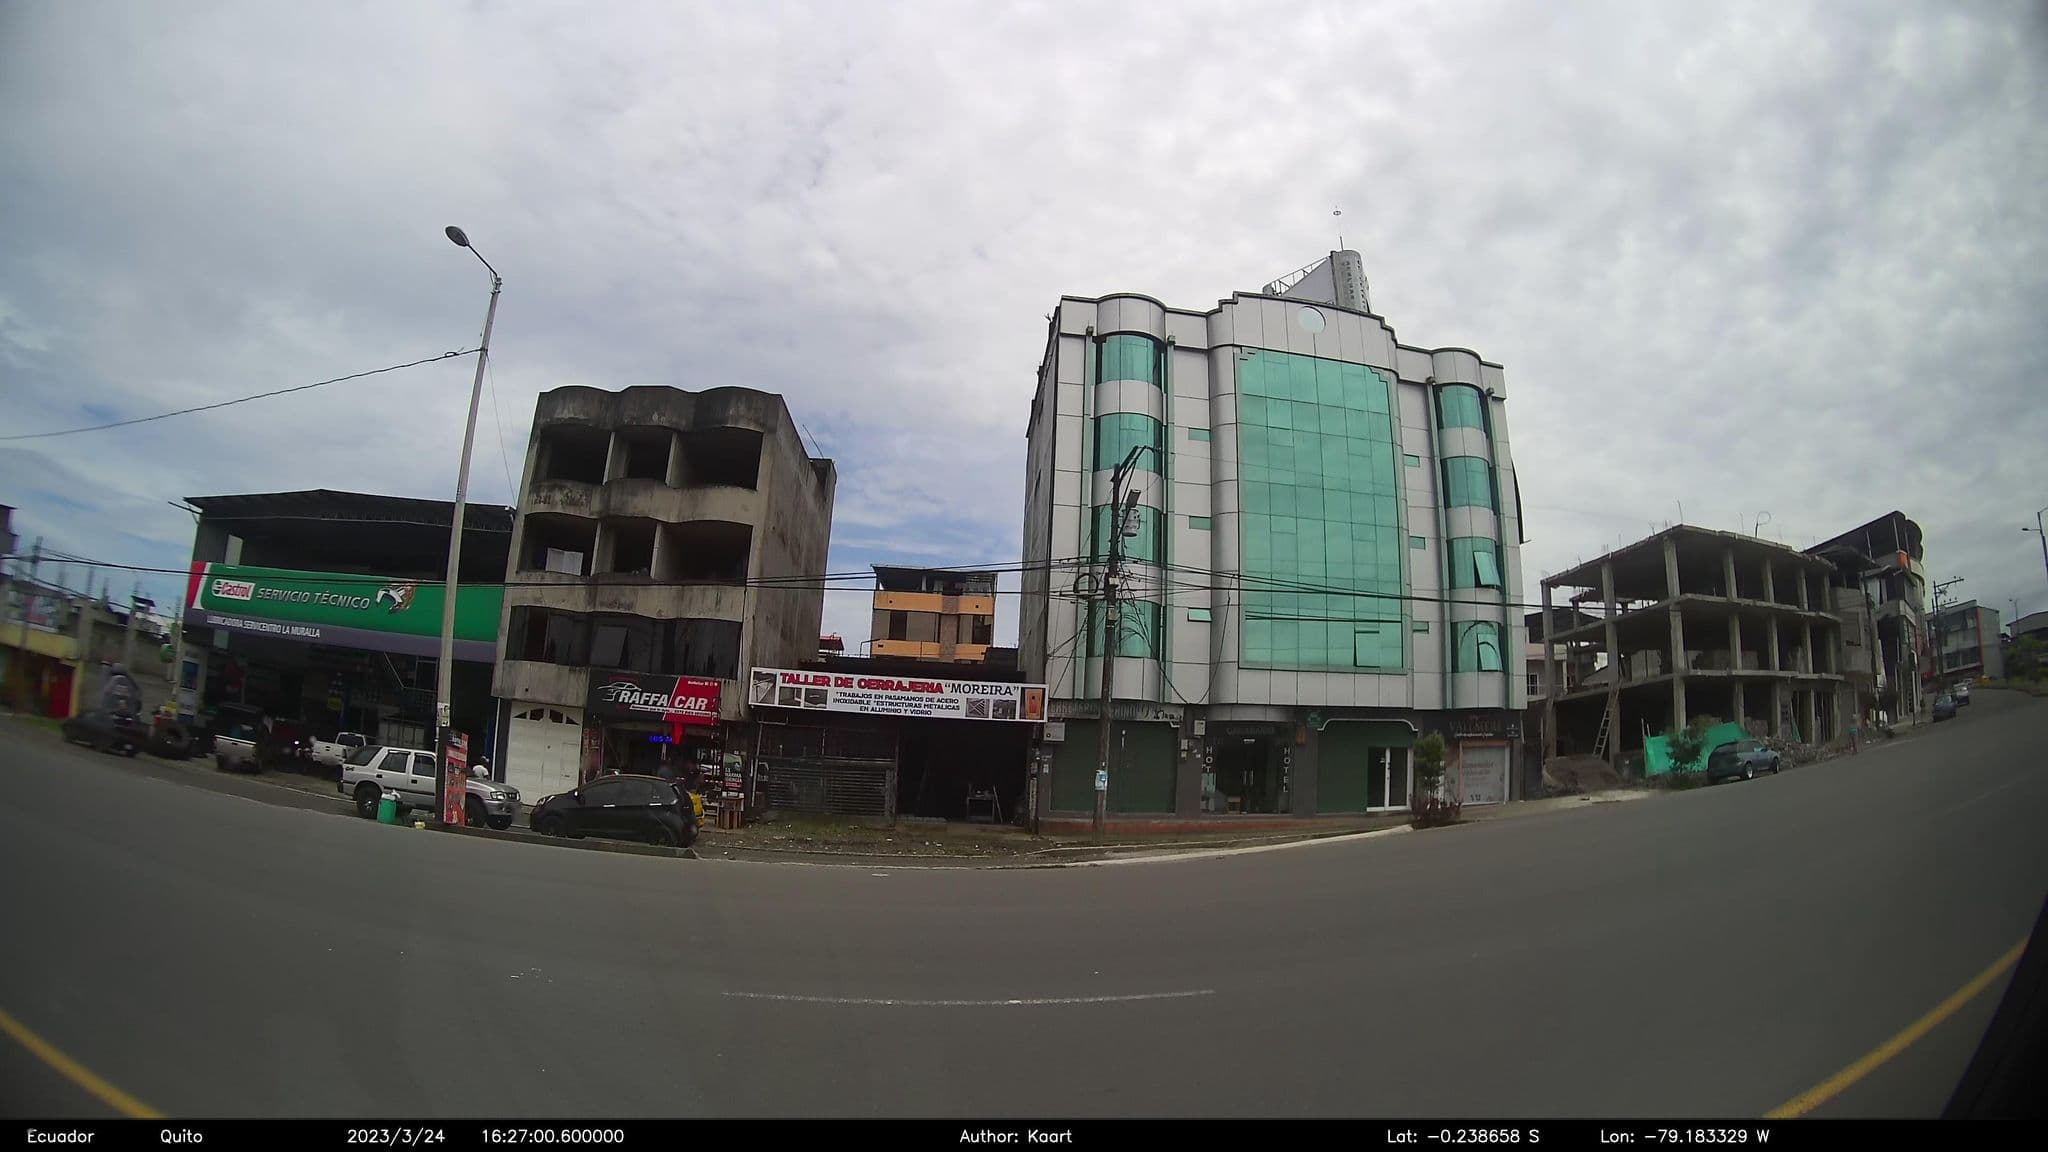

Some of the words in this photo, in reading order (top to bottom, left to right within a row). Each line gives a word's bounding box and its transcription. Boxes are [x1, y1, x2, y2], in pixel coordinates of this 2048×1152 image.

[221, 581, 253, 598] Castrol
[256, 587, 310, 604] SERVICIO
[313, 590, 371, 610] TÉCNICO
[282, 625, 290, 635] LA
[291, 626, 320, 638] MURALLA
[780, 672, 831, 687] TALLER
[834, 676, 855, 689] DE
[618, 690, 669, 707] RAFFA
[674, 696, 708, 711] CAR
[833, 698, 871, 706] INOXIDABLE
[885, 694, 924, 703] PASAMANOS
[1283, 747, 1291, 793] HOTEL
